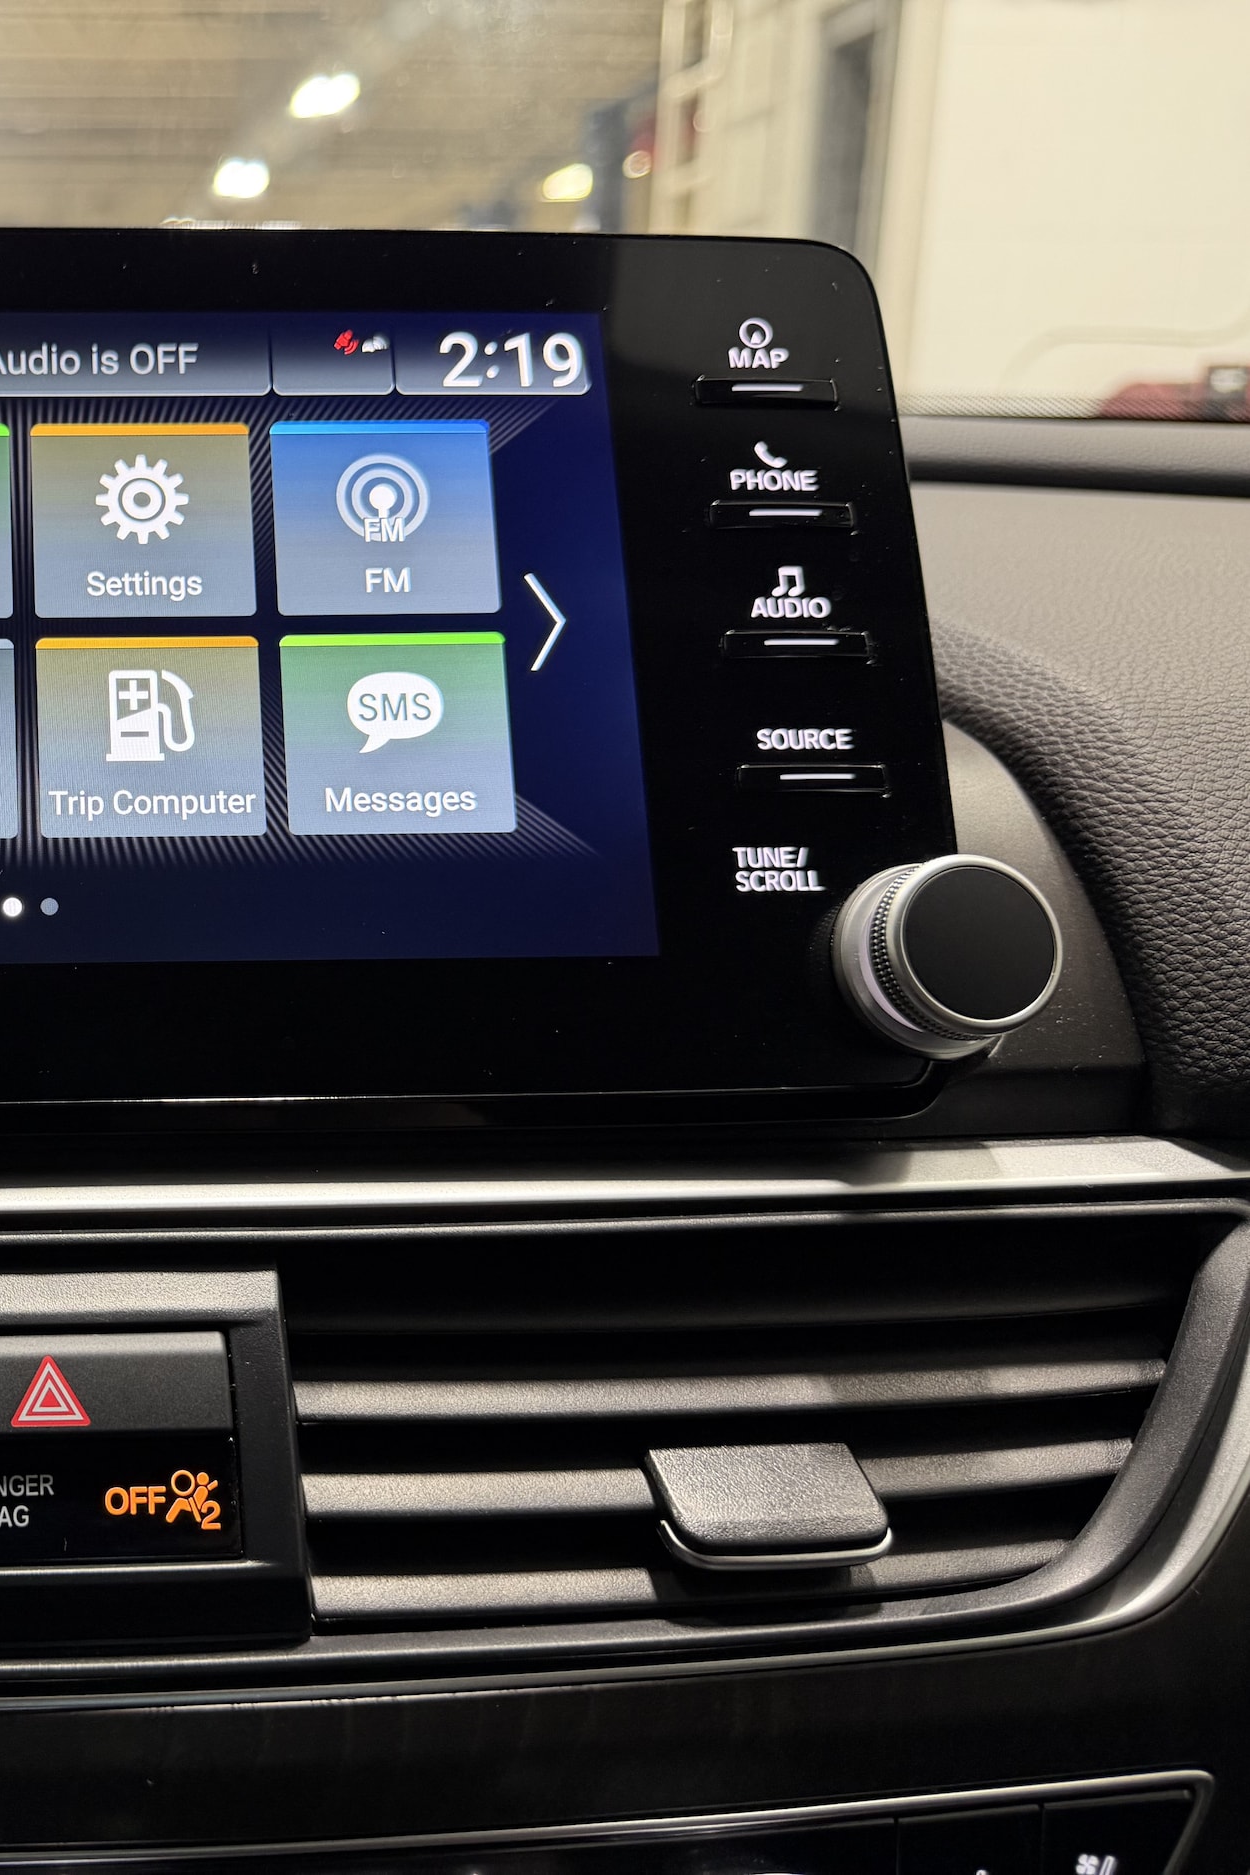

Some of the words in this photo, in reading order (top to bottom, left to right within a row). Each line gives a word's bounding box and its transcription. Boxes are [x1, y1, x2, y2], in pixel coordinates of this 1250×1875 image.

[91, 343, 119, 375] is
[129, 343, 199, 375] OFF
[438, 332, 585, 389] 2:19
[728, 347, 789, 369] MAP
[730, 469, 819, 491] PHONE
[364, 517, 406, 543] FM
[87, 571, 202, 602] Settings
[365, 567, 411, 593] FM
[751, 597, 832, 618] AUDIO
[357, 691, 433, 722] SMS
[756, 728, 854, 750] SOURCE
[48, 789, 105, 821] Trip
[113, 789, 257, 820] Computer
[324, 787, 477, 818] Messages
[732, 847, 809, 868] TUNE/
[735, 870, 827, 892] SCROLL
[104, 1485, 167, 1516] OFF
